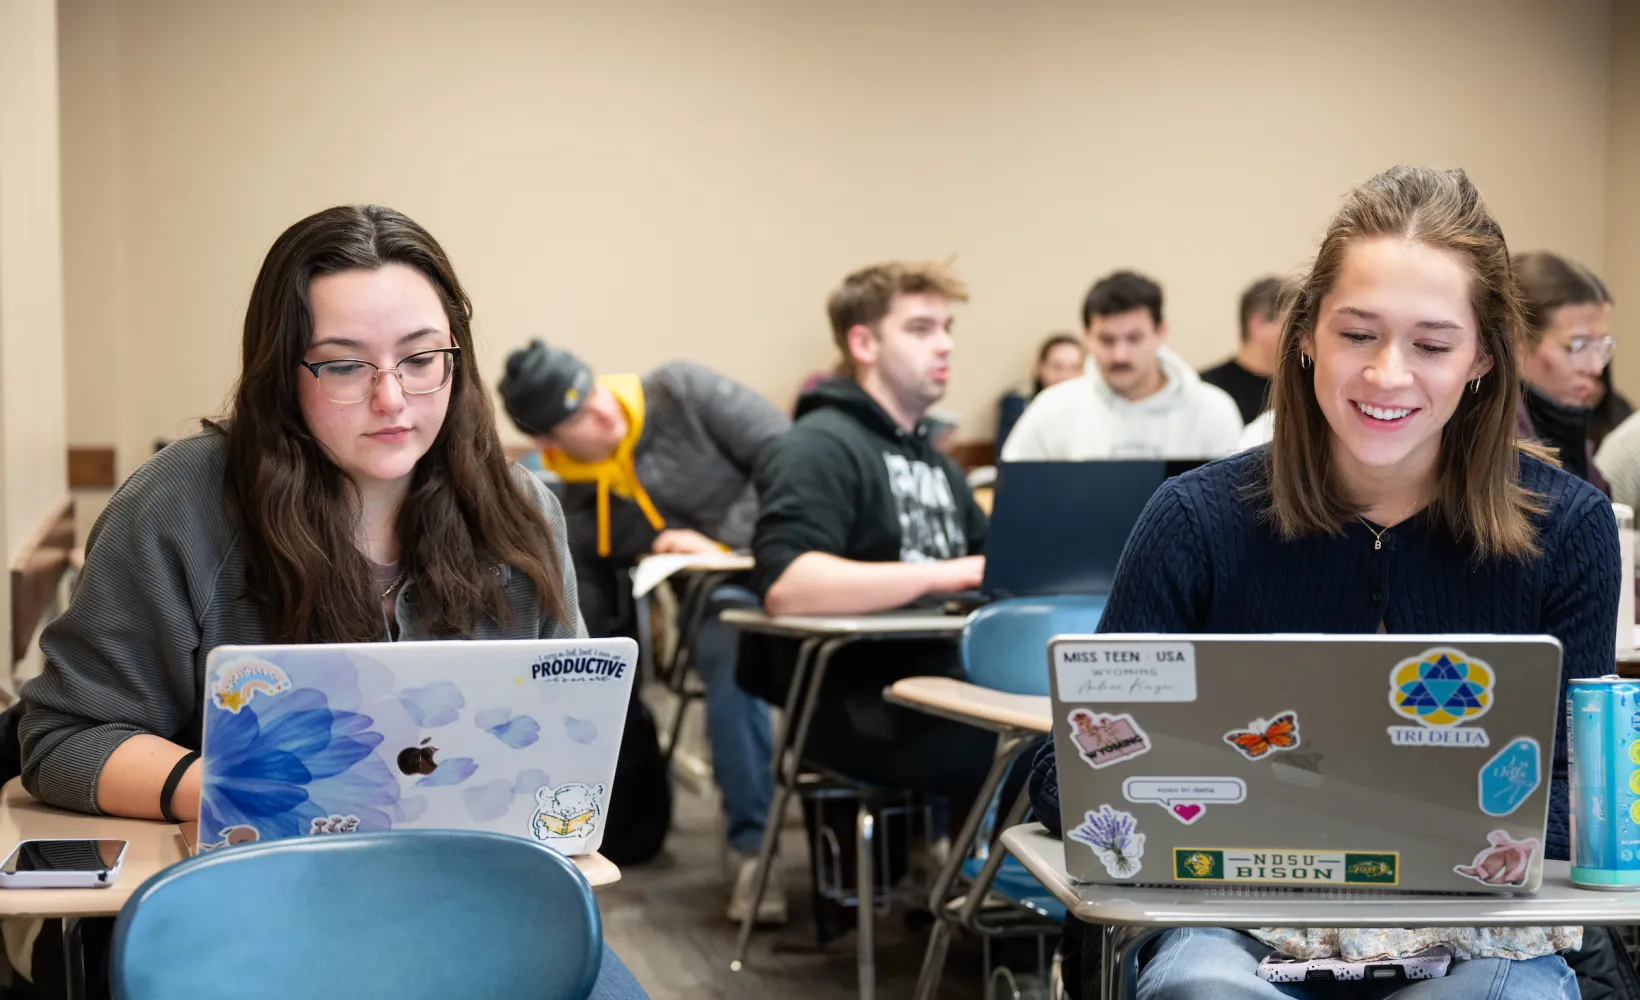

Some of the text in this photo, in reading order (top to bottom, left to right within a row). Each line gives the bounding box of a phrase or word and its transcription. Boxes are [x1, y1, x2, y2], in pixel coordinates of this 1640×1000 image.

[1374, 540, 1382, 550] B
[1063, 651, 1185, 663] MISS TEEN USA
[532, 658, 626, 679] PRODUCTIVE
[1091, 667, 1159, 677] WYOMING
[1394, 730, 1485, 744] TRI DELTA
[1085, 735, 1143, 759] WYOMING
[1253, 854, 1315, 866] NDSU
[1236, 866, 1333, 879] BISON
